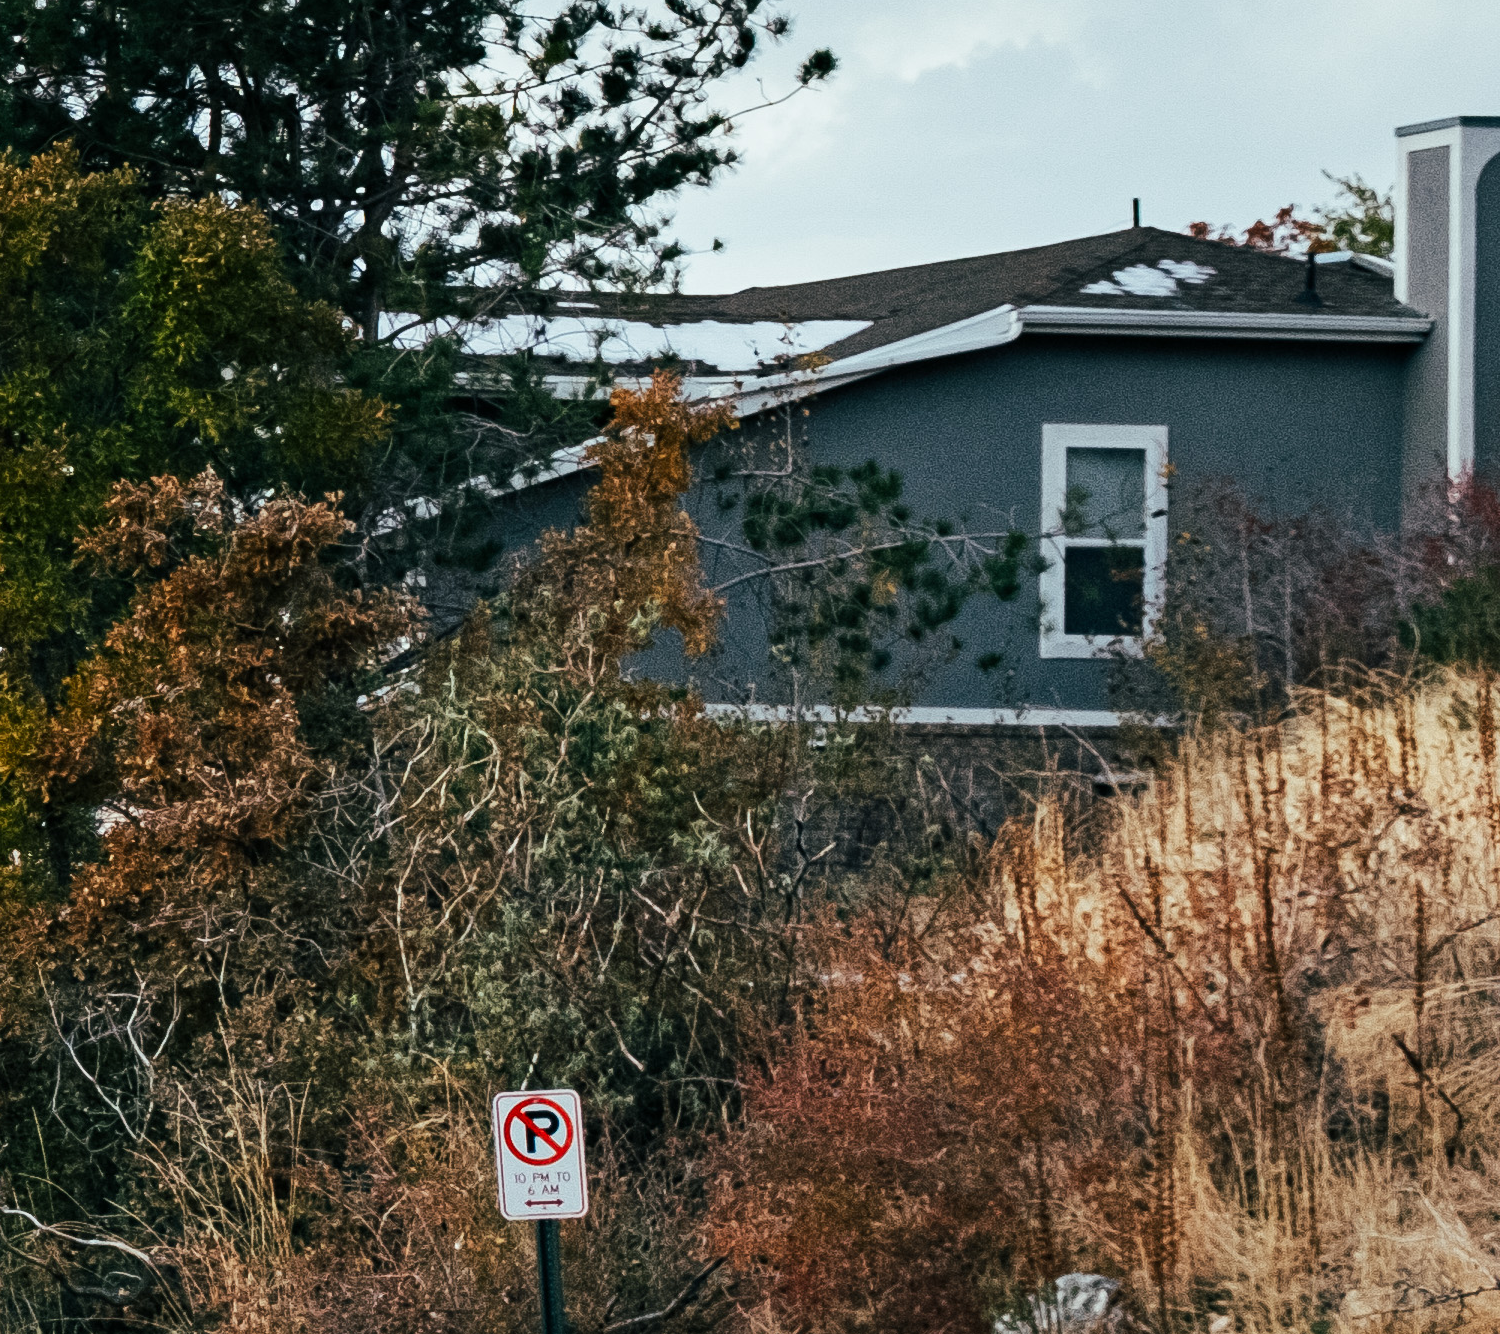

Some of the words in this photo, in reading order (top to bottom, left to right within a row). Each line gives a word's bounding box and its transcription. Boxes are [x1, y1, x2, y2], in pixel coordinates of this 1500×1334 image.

[514, 1172, 526, 1183] 10
[532, 1172, 549, 1183] PM
[557, 1171, 570, 1182] TO
[528, 1185, 535, 1195] 6
[542, 1184, 559, 1195] AM
